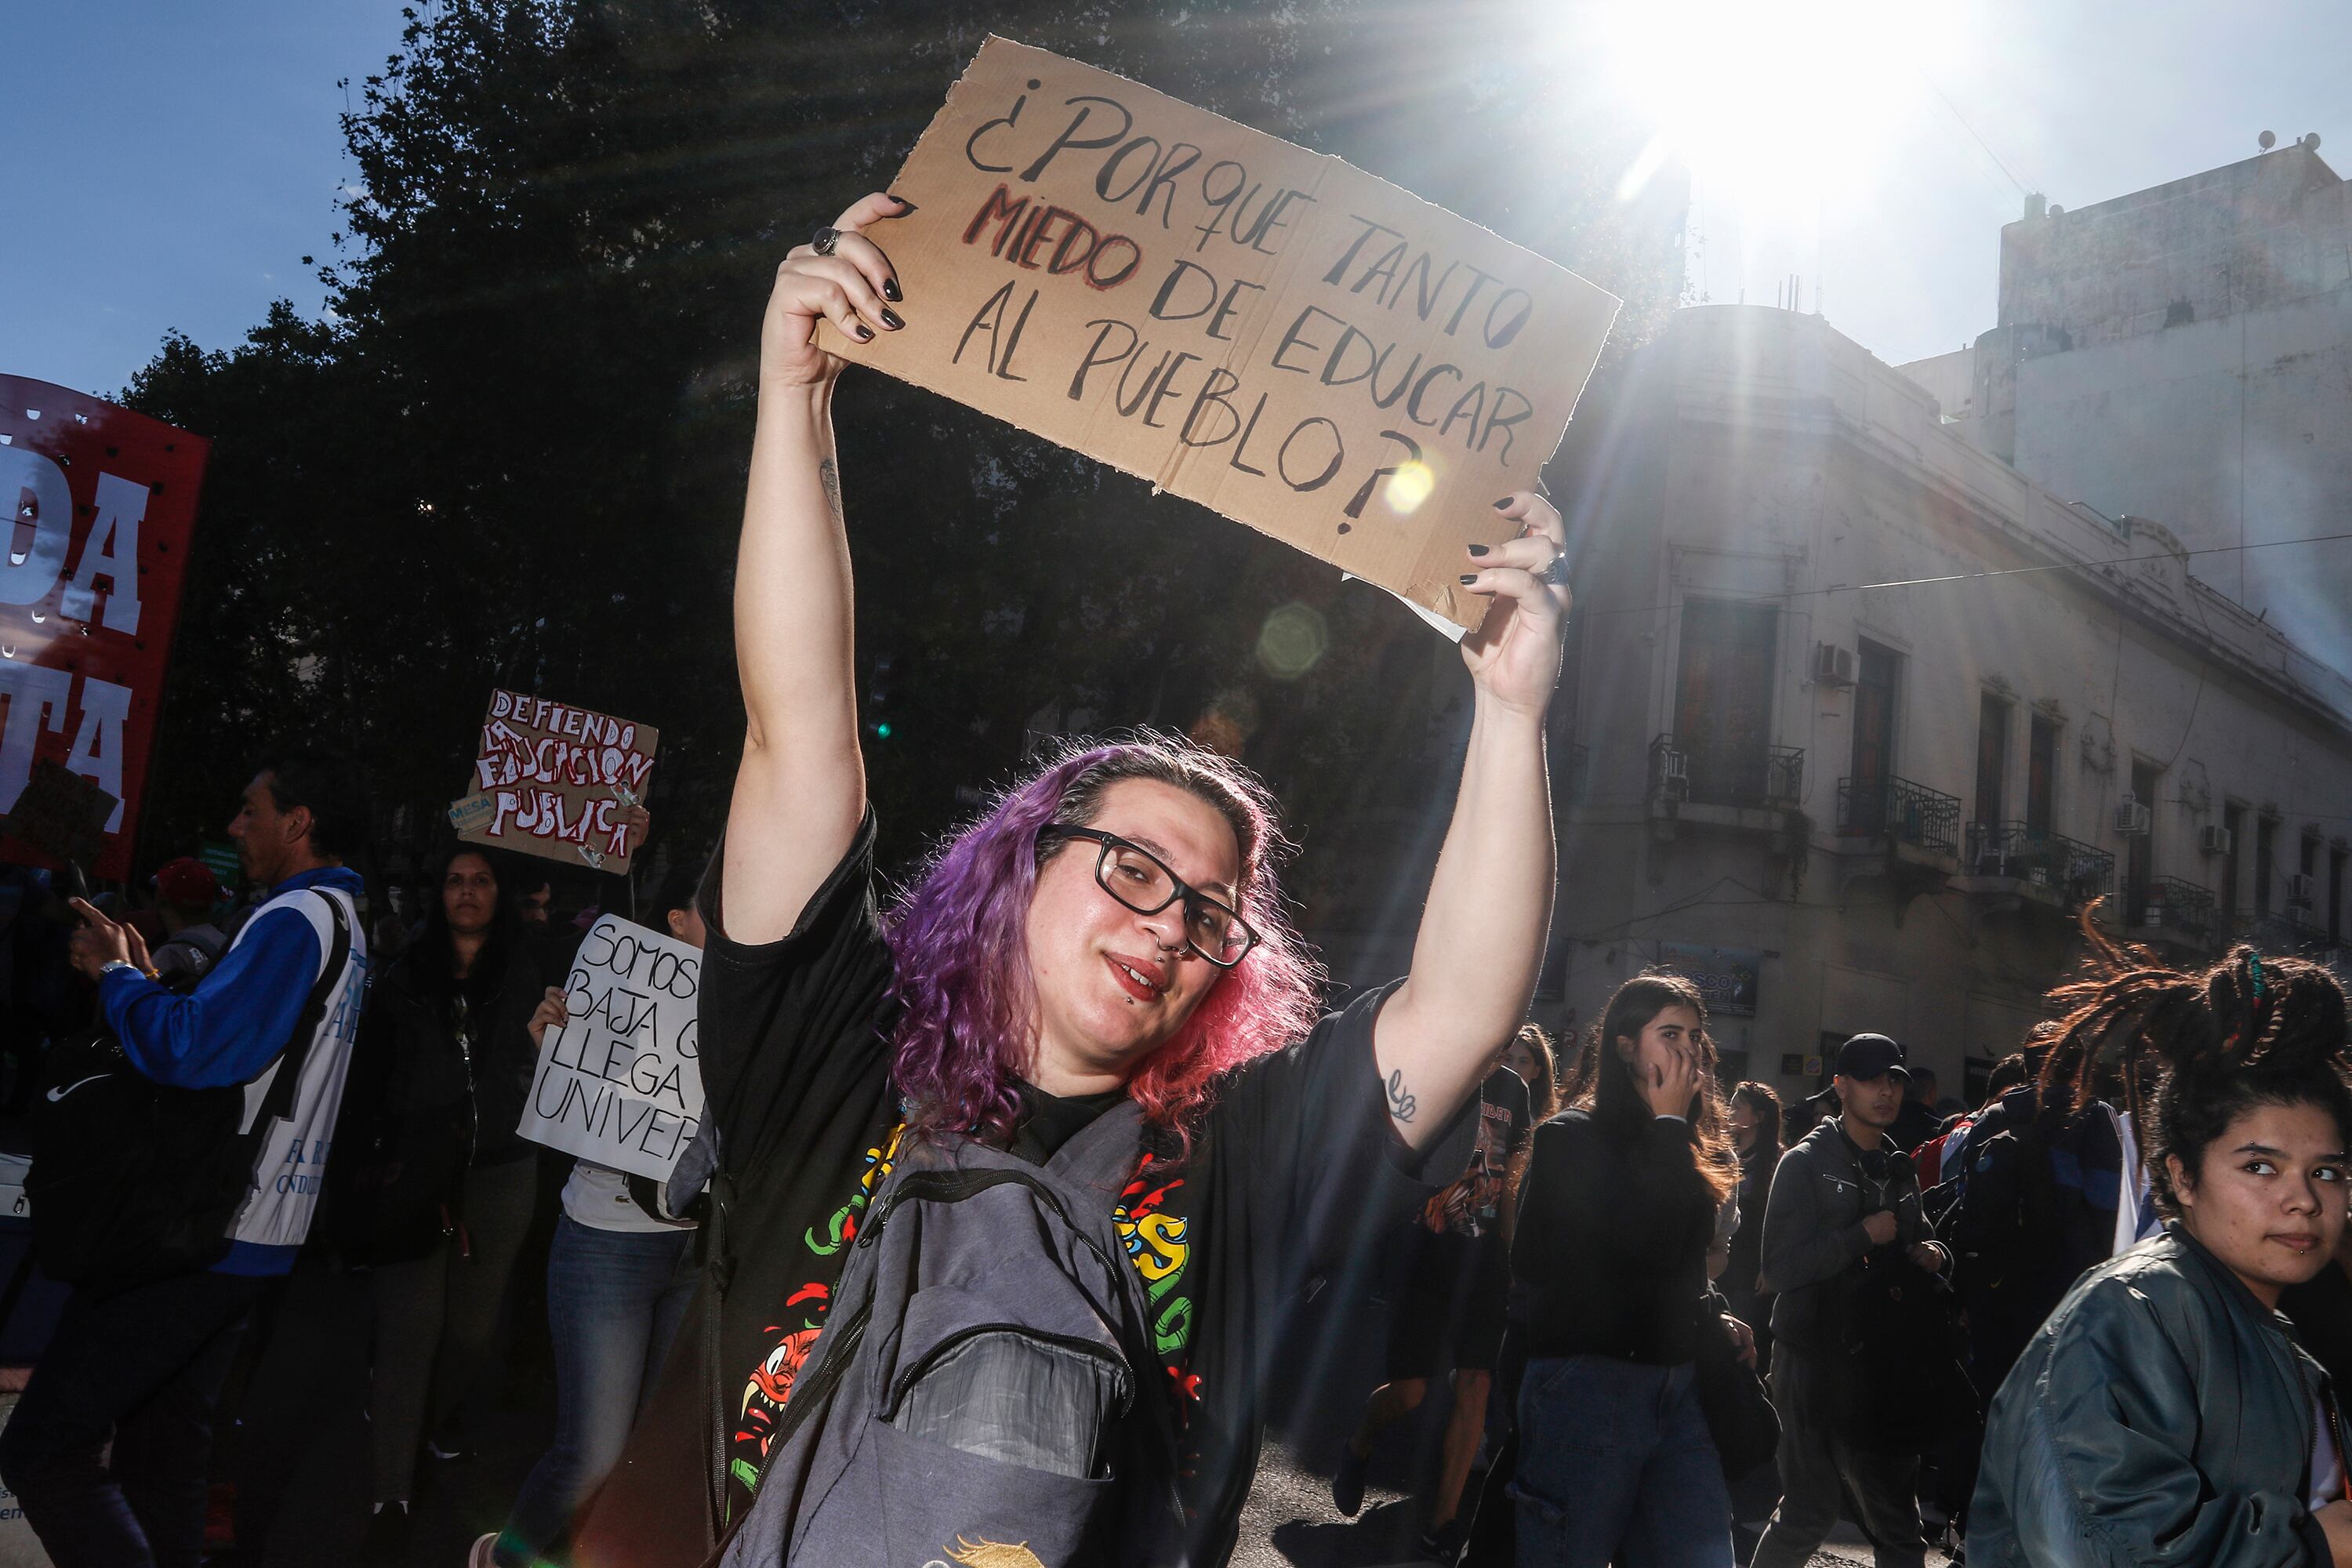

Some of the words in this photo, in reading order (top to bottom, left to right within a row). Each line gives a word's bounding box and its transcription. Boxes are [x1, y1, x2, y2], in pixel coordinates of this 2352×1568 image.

[1321, 213, 1533, 348] TANTO
[962, 182, 1142, 292] MIEDO
[1149, 260, 1266, 341] DE
[1270, 304, 1534, 466] EDUCAR
[951, 279, 1040, 382] AL
[1067, 318, 1423, 534] PUEBLO?
[0, 444, 150, 636] DA
[0, 657, 132, 833] TA
[482, 719, 523, 753] LA
[491, 690, 636, 750] DEFIENDO
[485, 786, 628, 858] PUBLICA
[583, 924, 699, 999] SOMOS
[566, 968, 658, 1048] BAJA
[550, 1028, 685, 1110] LLEGA
